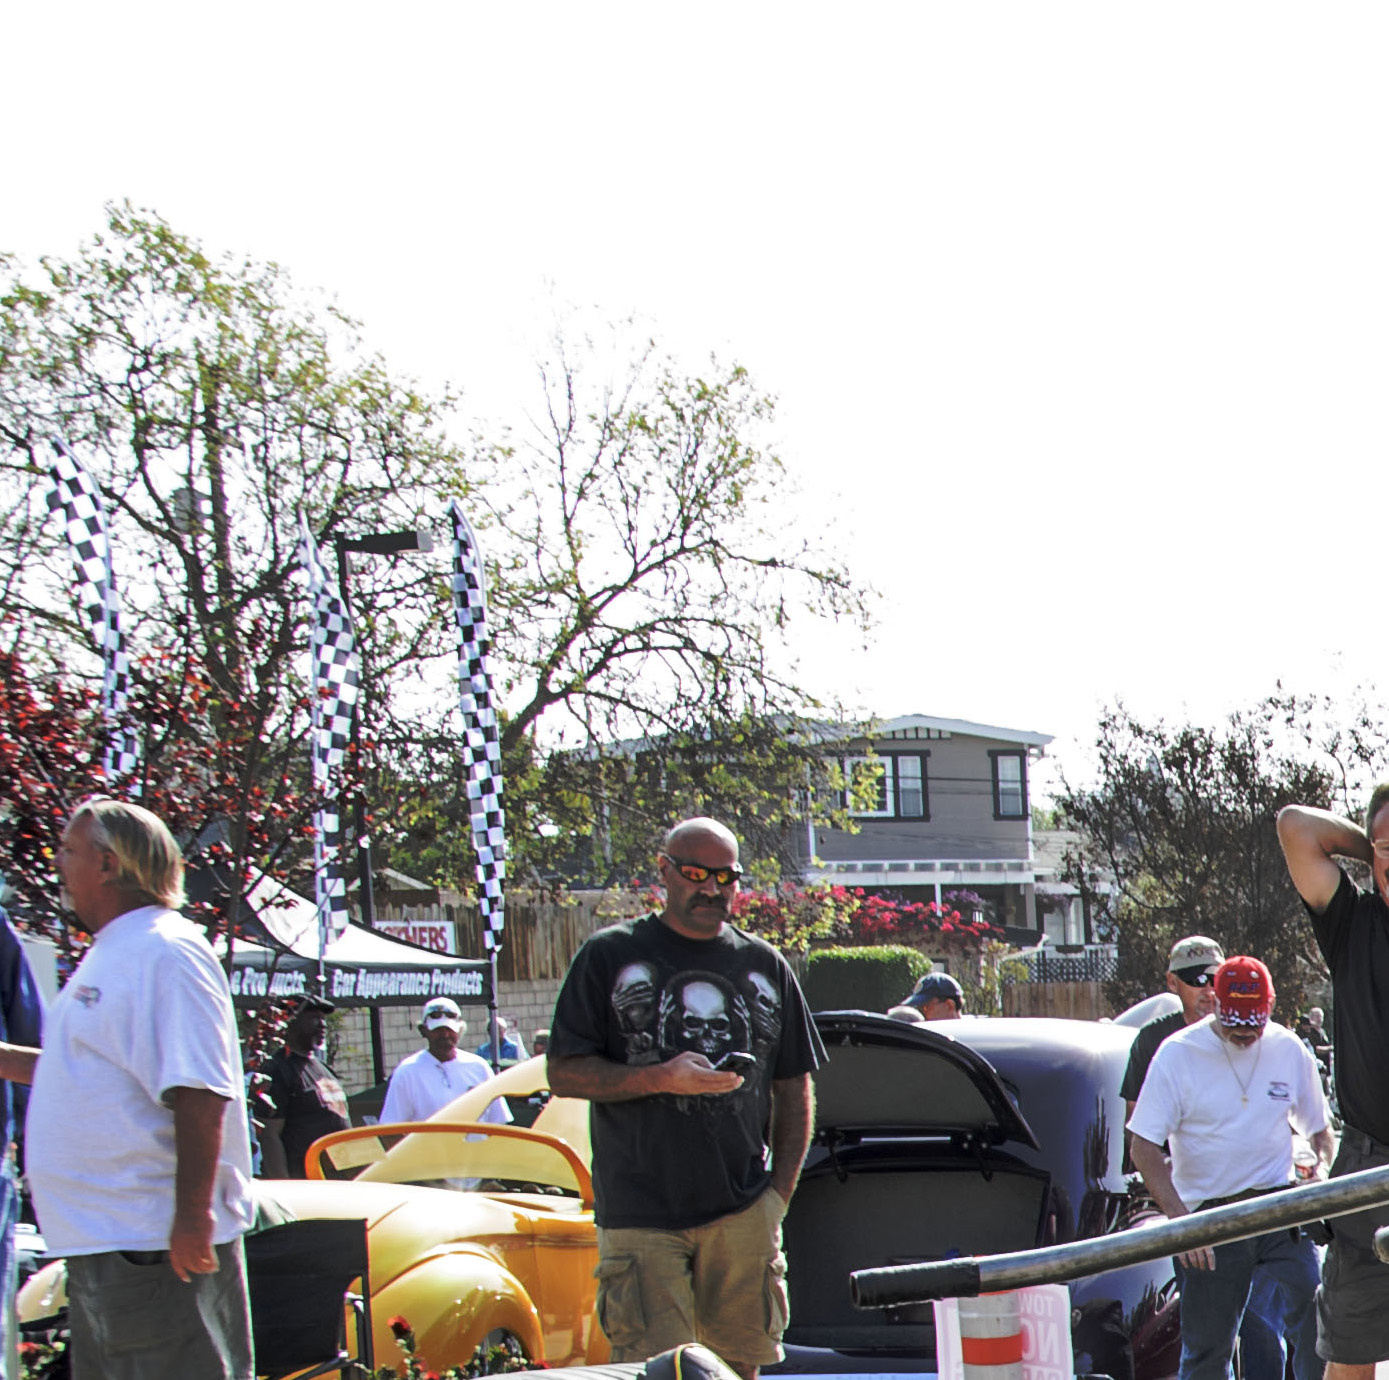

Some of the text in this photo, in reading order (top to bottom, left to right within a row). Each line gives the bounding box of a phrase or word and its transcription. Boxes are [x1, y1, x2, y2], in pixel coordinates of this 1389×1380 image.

[377, 926, 448, 952] HERS
[242, 966, 306, 997] Proucts
[332, 968, 484, 999] Car Appearance Products
